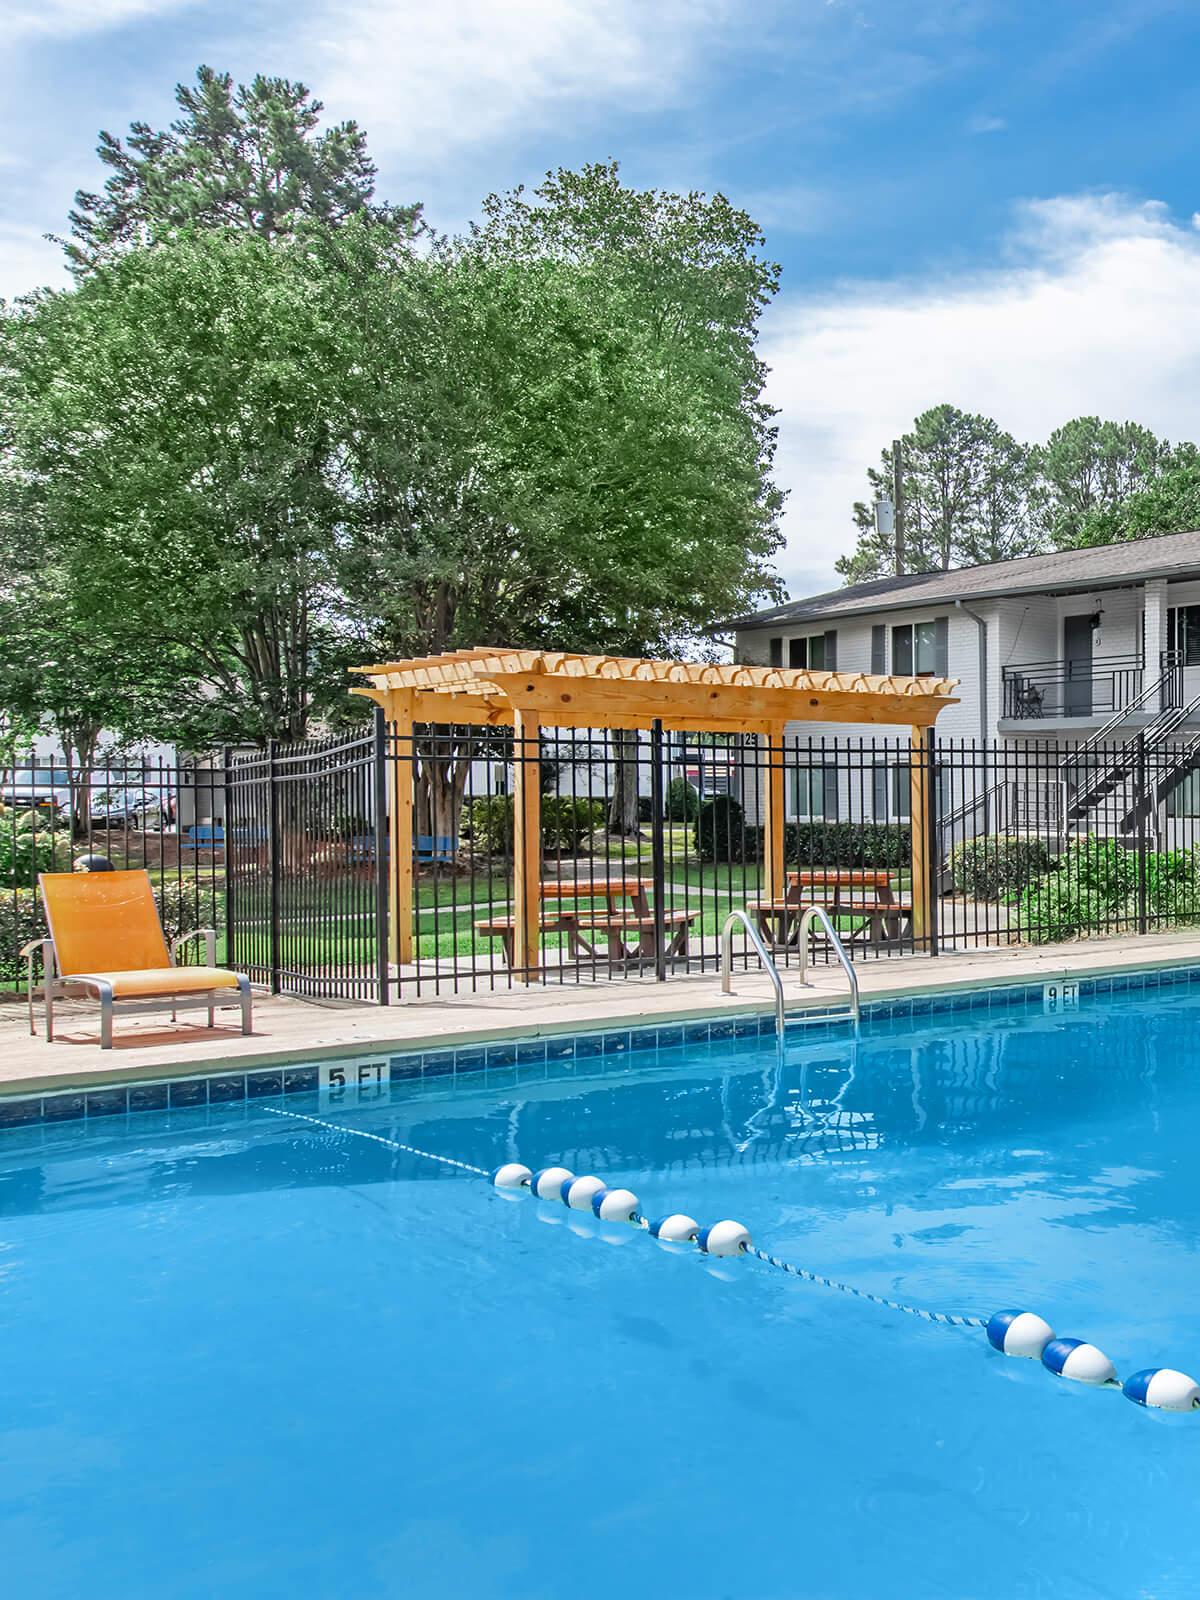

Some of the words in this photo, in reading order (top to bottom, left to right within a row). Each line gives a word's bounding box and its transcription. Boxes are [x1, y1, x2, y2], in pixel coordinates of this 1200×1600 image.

[1049, 986, 1057, 1000] 9
[328, 1067, 345, 1087] 5
[358, 1062, 386, 1084] FT
